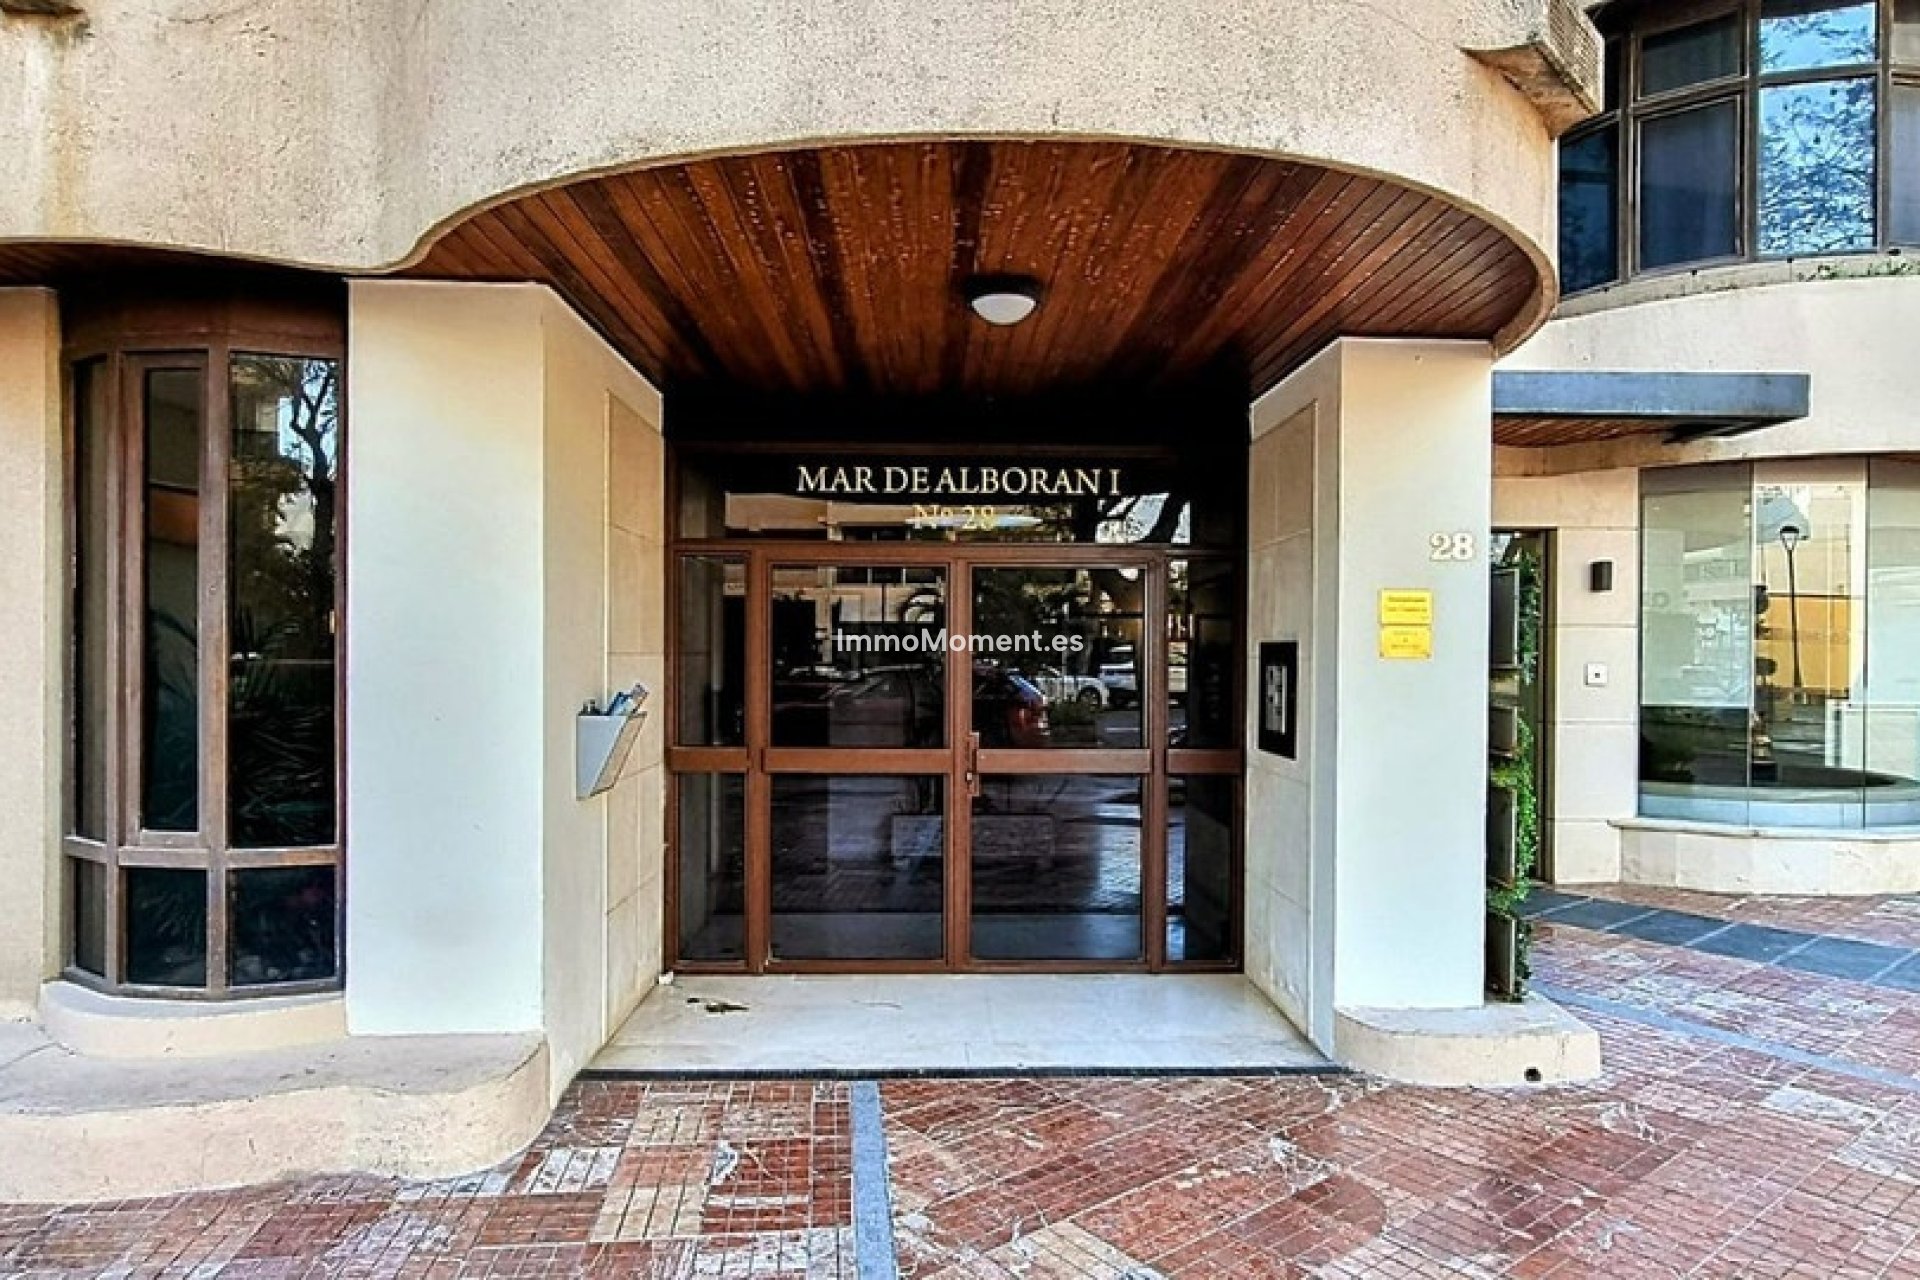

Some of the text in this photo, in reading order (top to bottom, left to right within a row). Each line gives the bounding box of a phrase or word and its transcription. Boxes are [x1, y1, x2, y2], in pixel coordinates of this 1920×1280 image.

[797, 466, 1122, 495] MAR DE ALBORAN I
[961, 504, 995, 531] 28
[1430, 532, 1473, 561] 28
